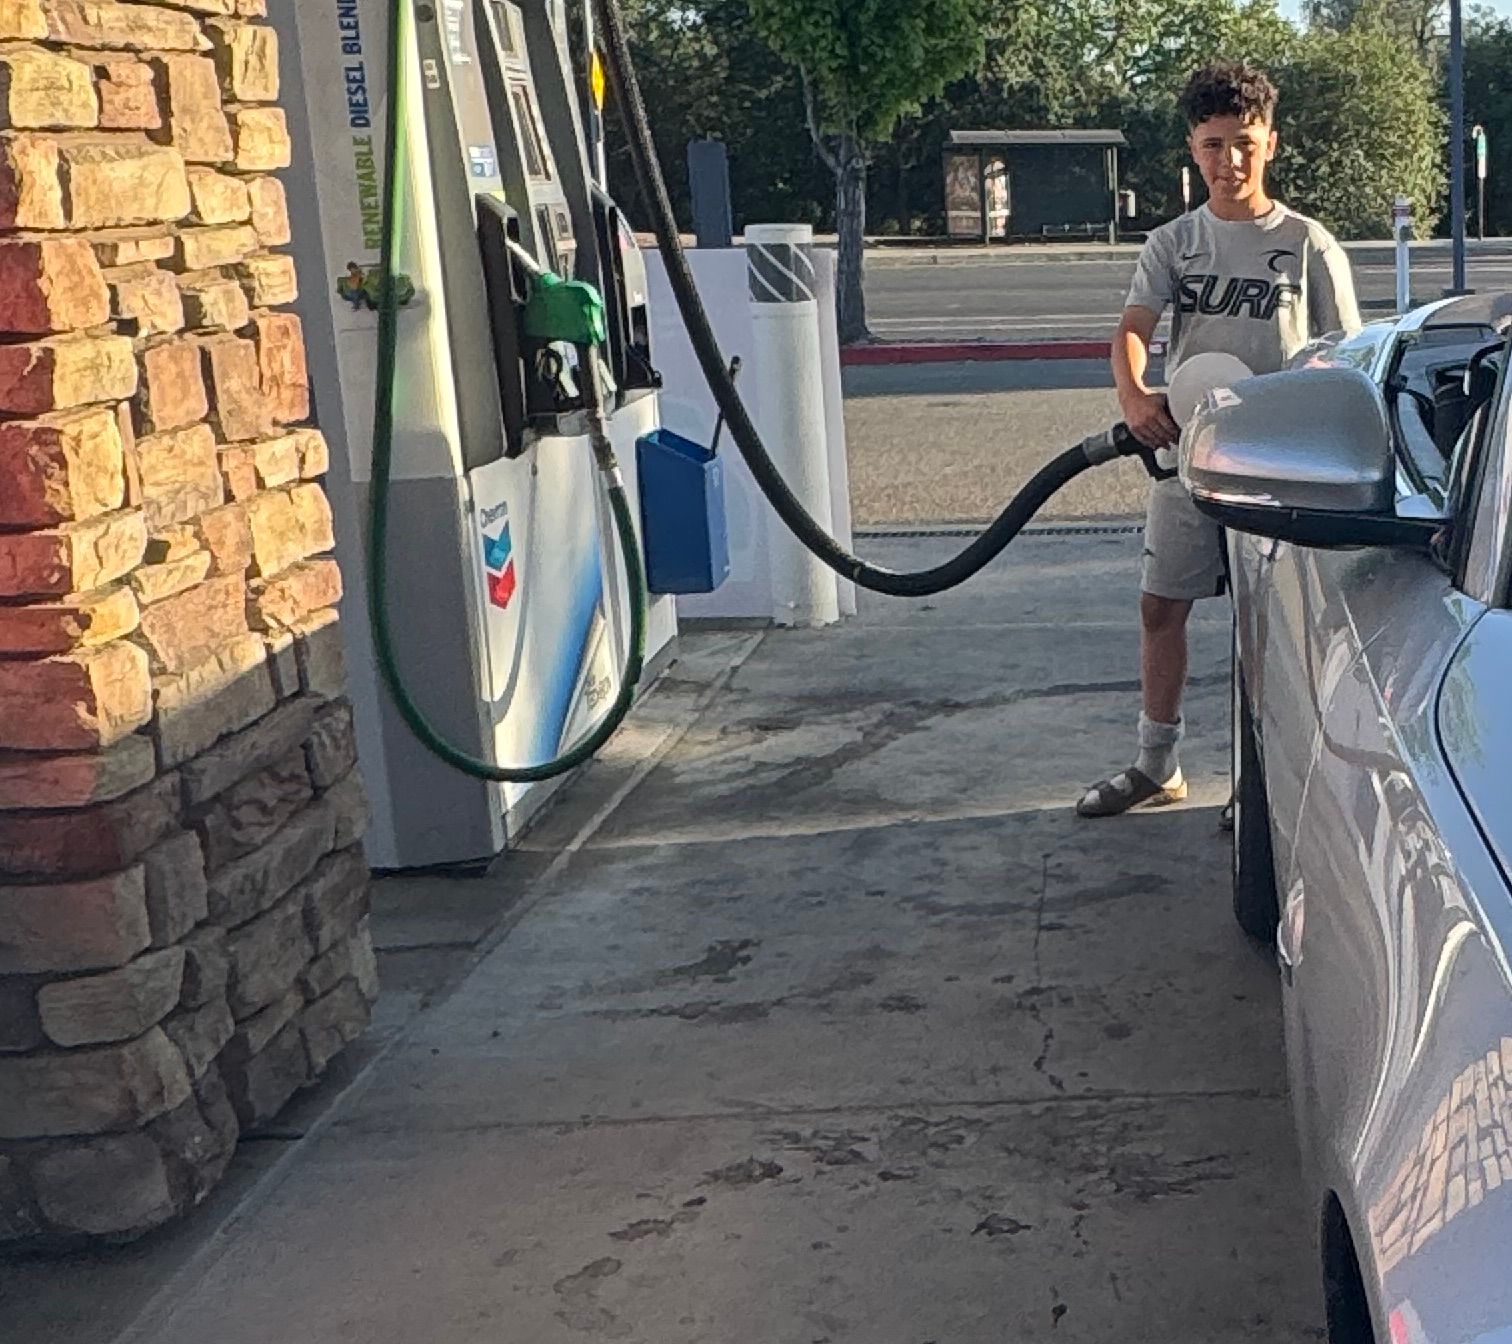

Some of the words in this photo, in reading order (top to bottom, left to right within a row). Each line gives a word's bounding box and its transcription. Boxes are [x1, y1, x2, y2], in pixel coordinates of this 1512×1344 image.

[345, 61, 371, 128] DIESEL
[352, 134, 384, 250] RENEWABLE
[1179, 274, 1303, 320] SURF
